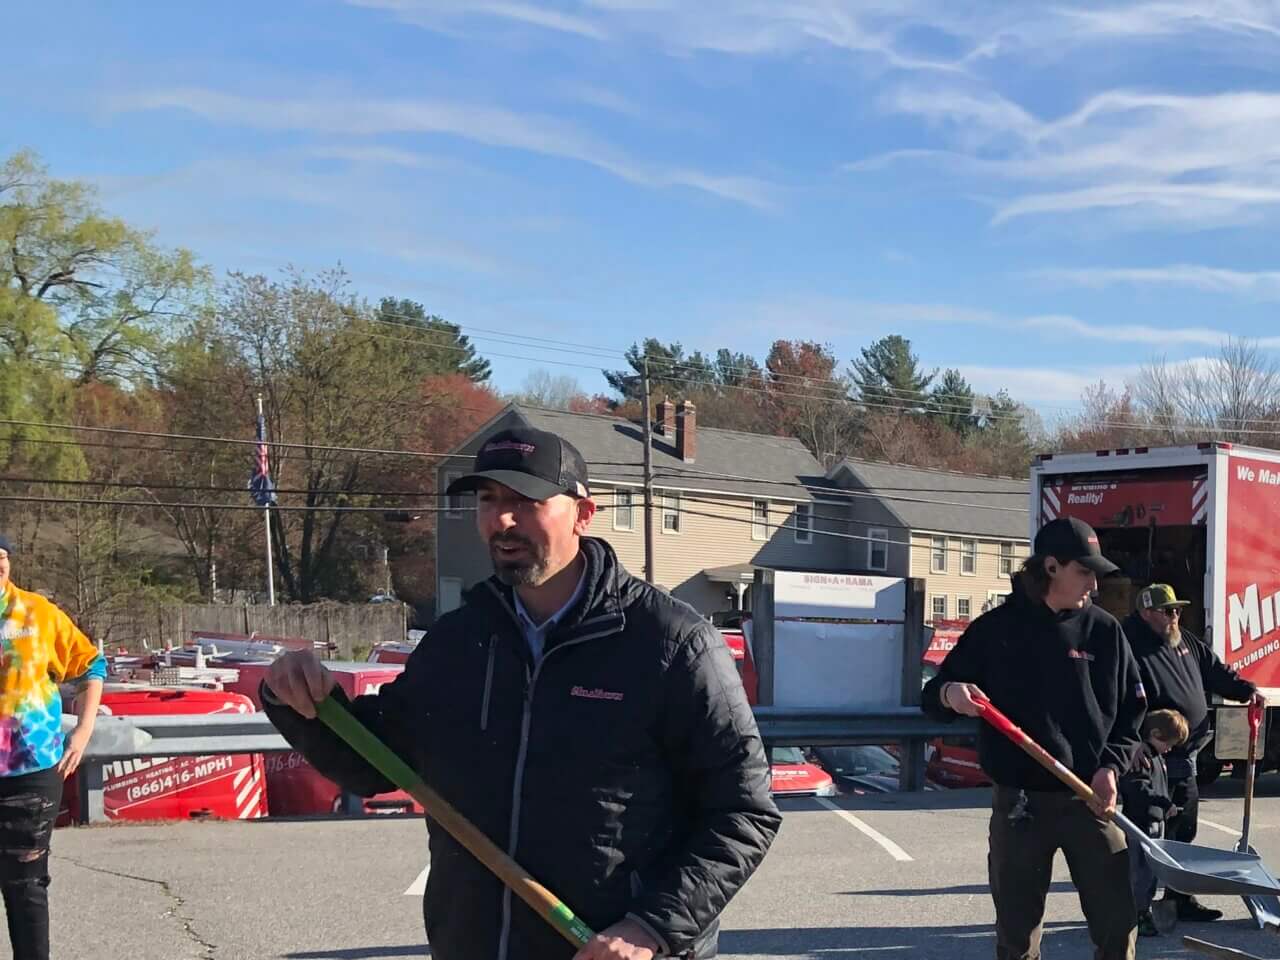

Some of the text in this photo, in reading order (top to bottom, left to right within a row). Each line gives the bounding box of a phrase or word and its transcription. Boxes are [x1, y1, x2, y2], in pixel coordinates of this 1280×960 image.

[1236, 465, 1255, 481] We
[1232, 639, 1280, 671] PLUMBING
[127, 755, 233, 803] (866)416-MPH1
